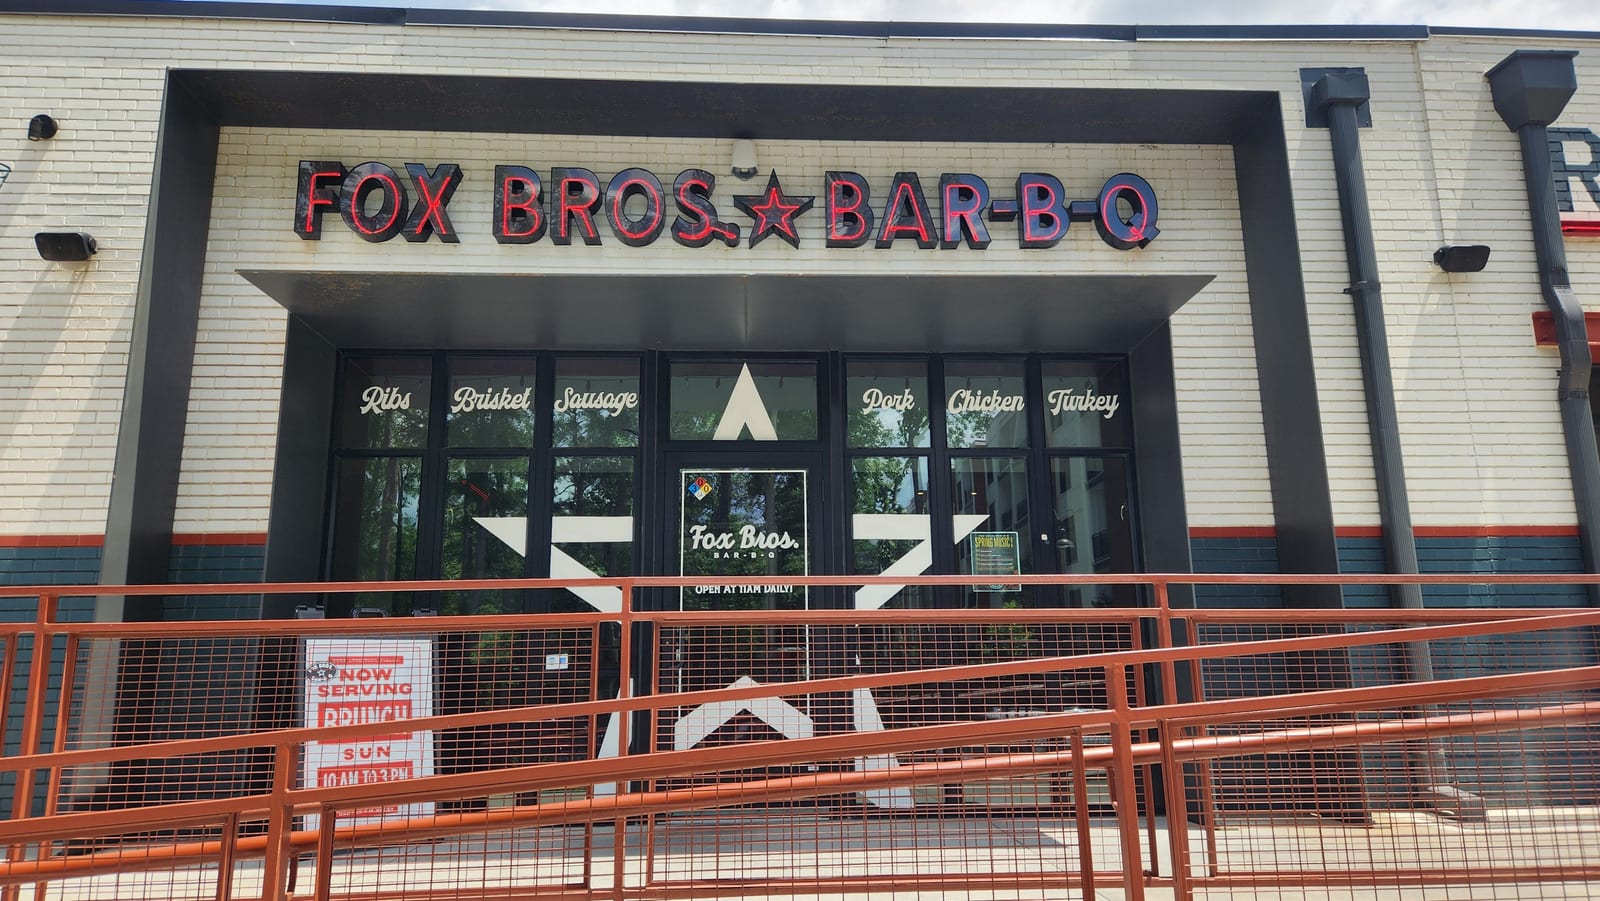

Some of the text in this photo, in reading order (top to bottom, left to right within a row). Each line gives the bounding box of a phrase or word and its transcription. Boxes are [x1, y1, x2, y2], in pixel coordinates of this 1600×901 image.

[293, 160, 1160, 250] FOX BROS. BAR-B-Q
[360, 386, 412, 415] Ribs
[450, 387, 533, 415] Brisket
[553, 386, 638, 417] Sausage
[862, 388, 915, 415] Pork
[947, 388, 1025, 415] Chicken
[1047, 389, 1120, 419] Turkey
[689, 524, 800, 550] Fox Bros.
[695, 585, 721, 594] OPEN
[723, 585, 737, 594] AT
[763, 584, 793, 593] DAILY!
[339, 667, 393, 681] NOW
[318, 682, 412, 698] SERVING
[343, 745, 391, 760] SUN
[323, 767, 409, 787] 10 AM TO 3 PM
